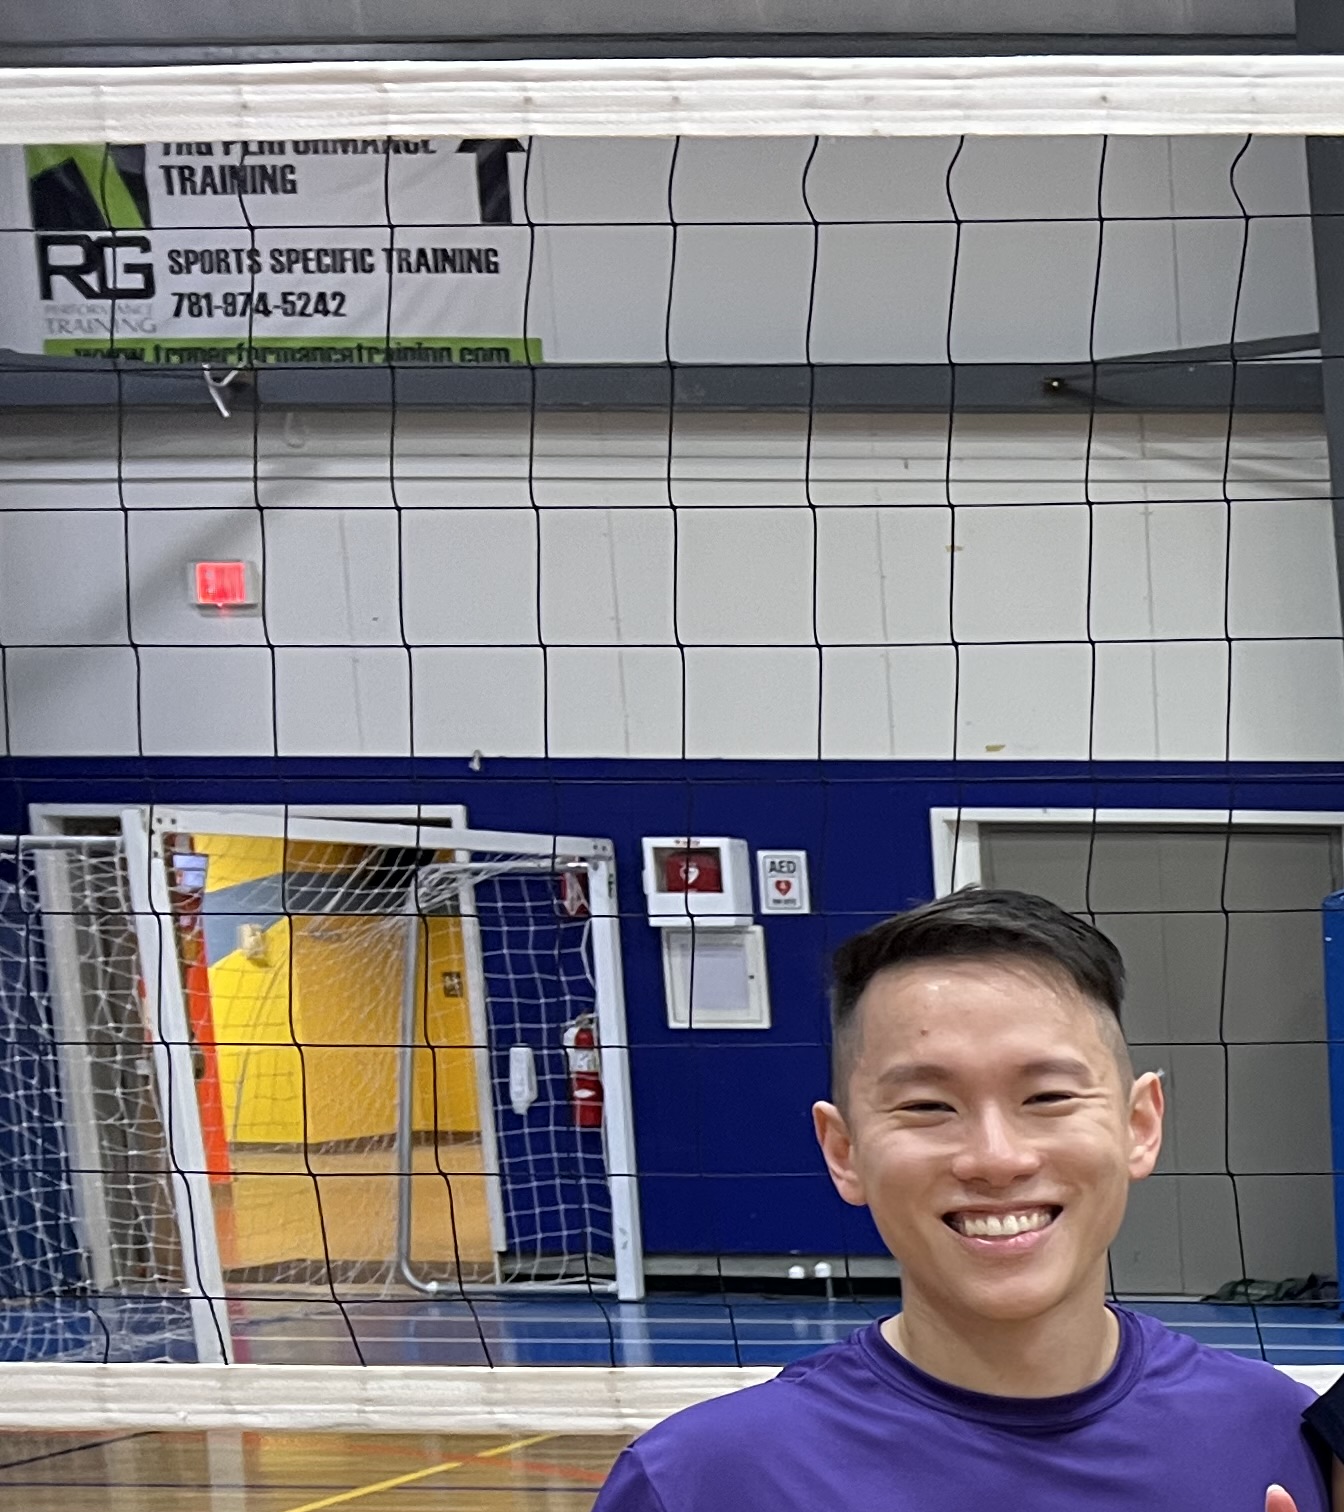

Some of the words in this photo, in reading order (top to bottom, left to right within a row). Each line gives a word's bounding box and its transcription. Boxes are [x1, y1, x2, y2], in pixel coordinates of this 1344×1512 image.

[159, 164, 298, 196] TRAINING
[35, 234, 156, 301] RG
[167, 248, 262, 275] SPORTS
[269, 248, 375, 275] SPECIFIC
[381, 248, 500, 274] TRAINING
[768, 860, 797, 874] AED
